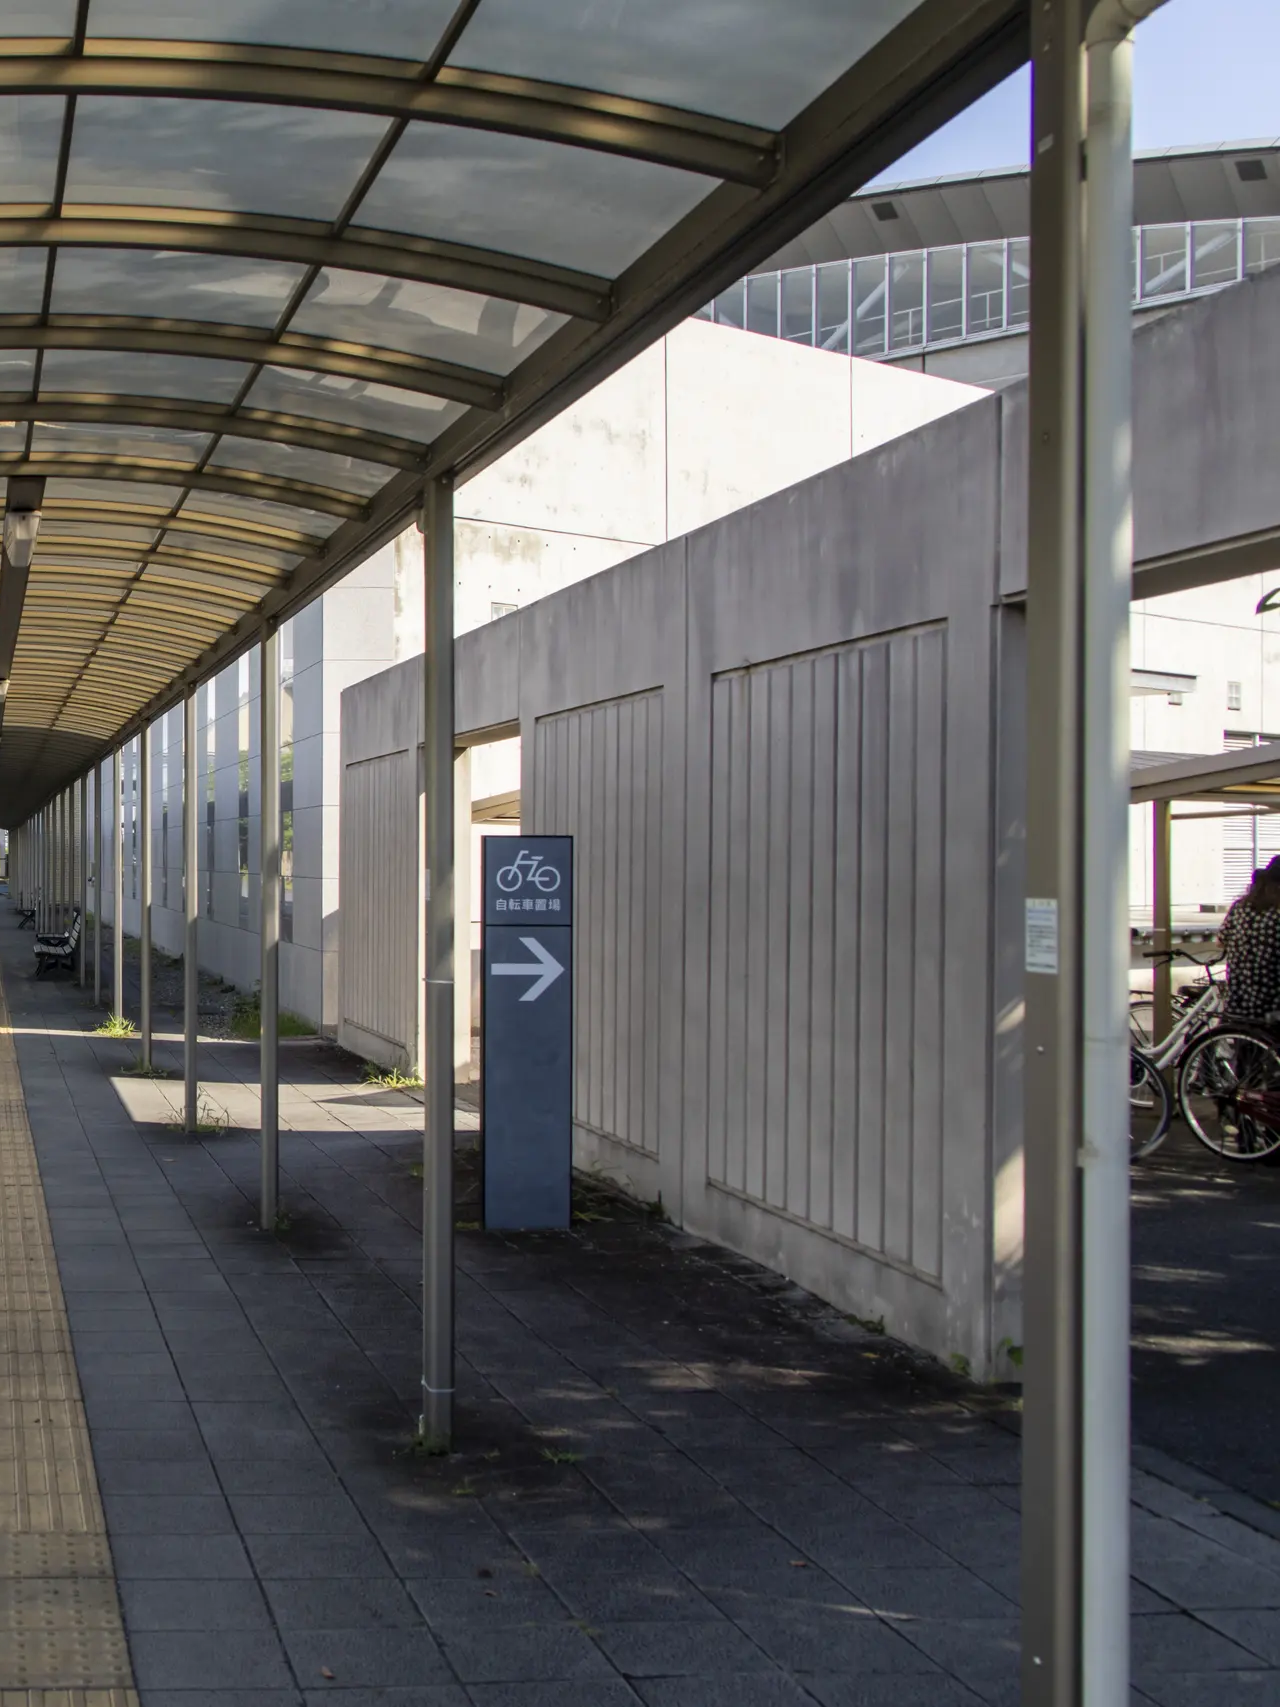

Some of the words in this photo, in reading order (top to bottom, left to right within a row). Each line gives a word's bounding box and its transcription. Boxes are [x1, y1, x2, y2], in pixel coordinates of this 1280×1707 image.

[496, 899, 561, 911] 自転車置場
